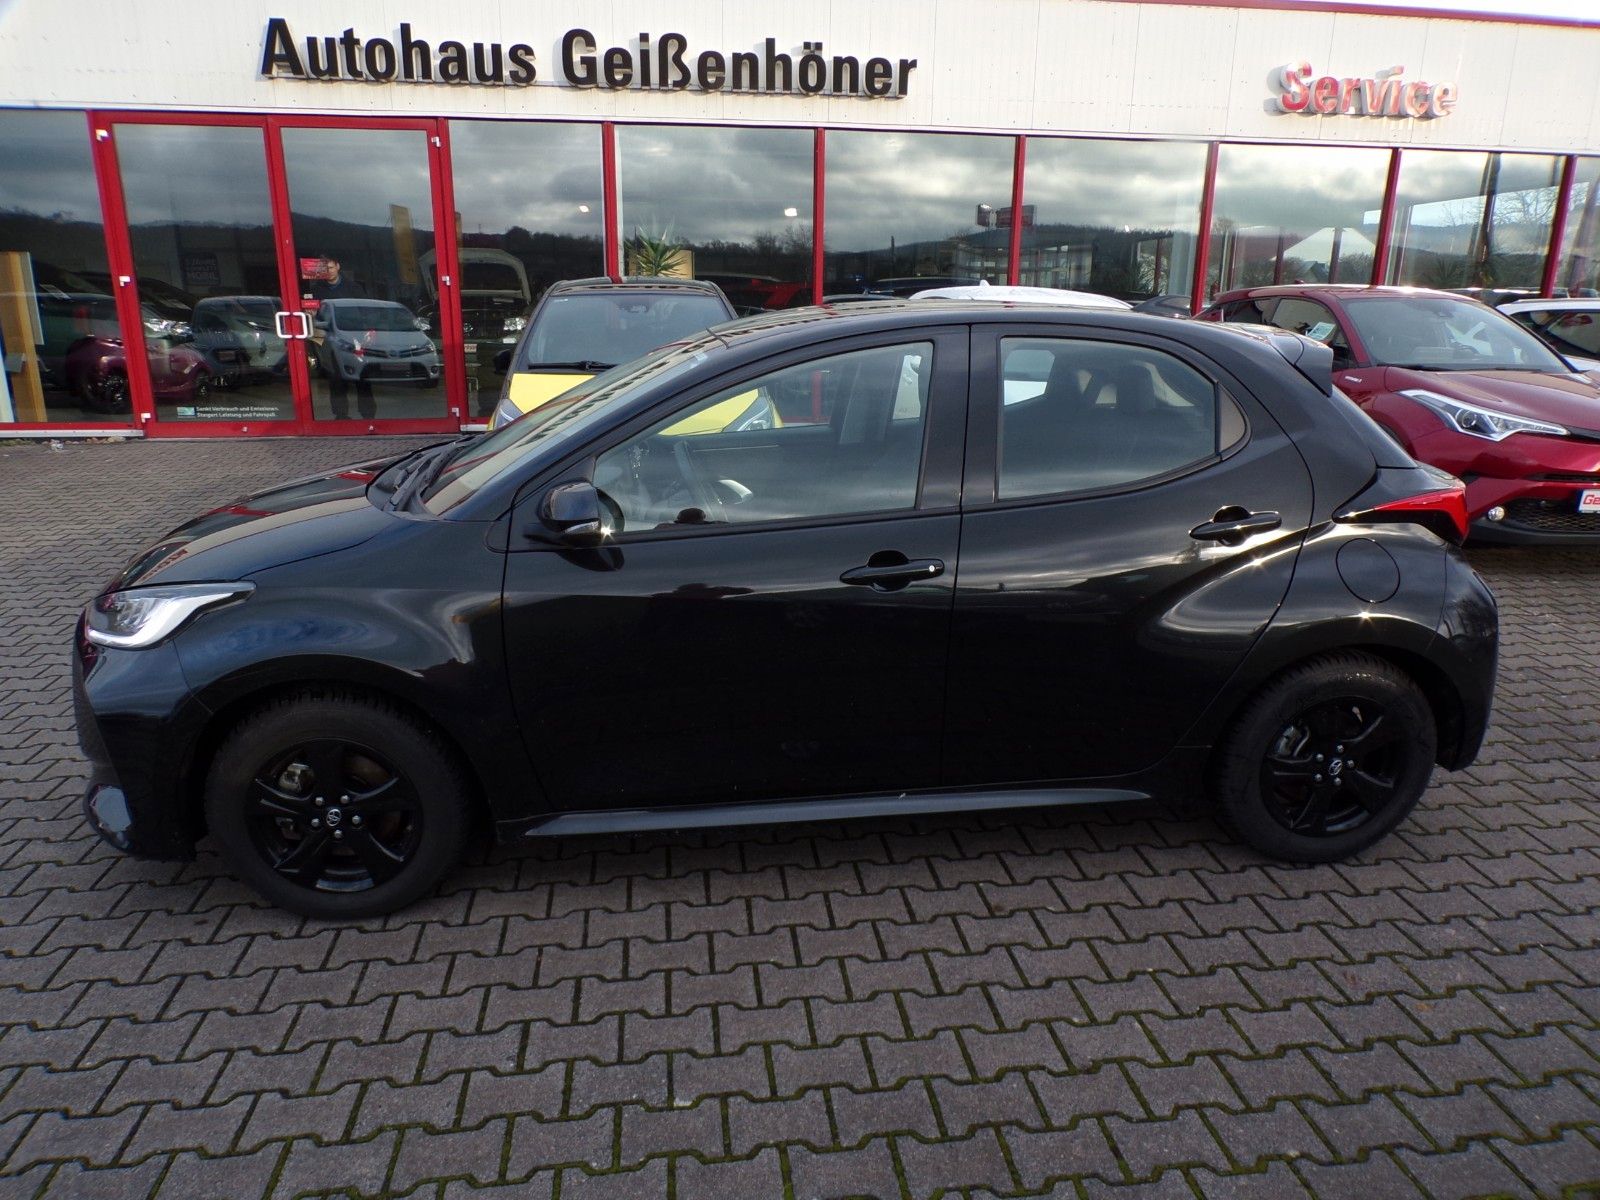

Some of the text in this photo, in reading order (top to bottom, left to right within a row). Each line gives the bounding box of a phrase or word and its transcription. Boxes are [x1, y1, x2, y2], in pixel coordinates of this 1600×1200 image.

[261, 18, 918, 97] Autohaus Geißenhöner
[1280, 62, 1458, 116] Service
